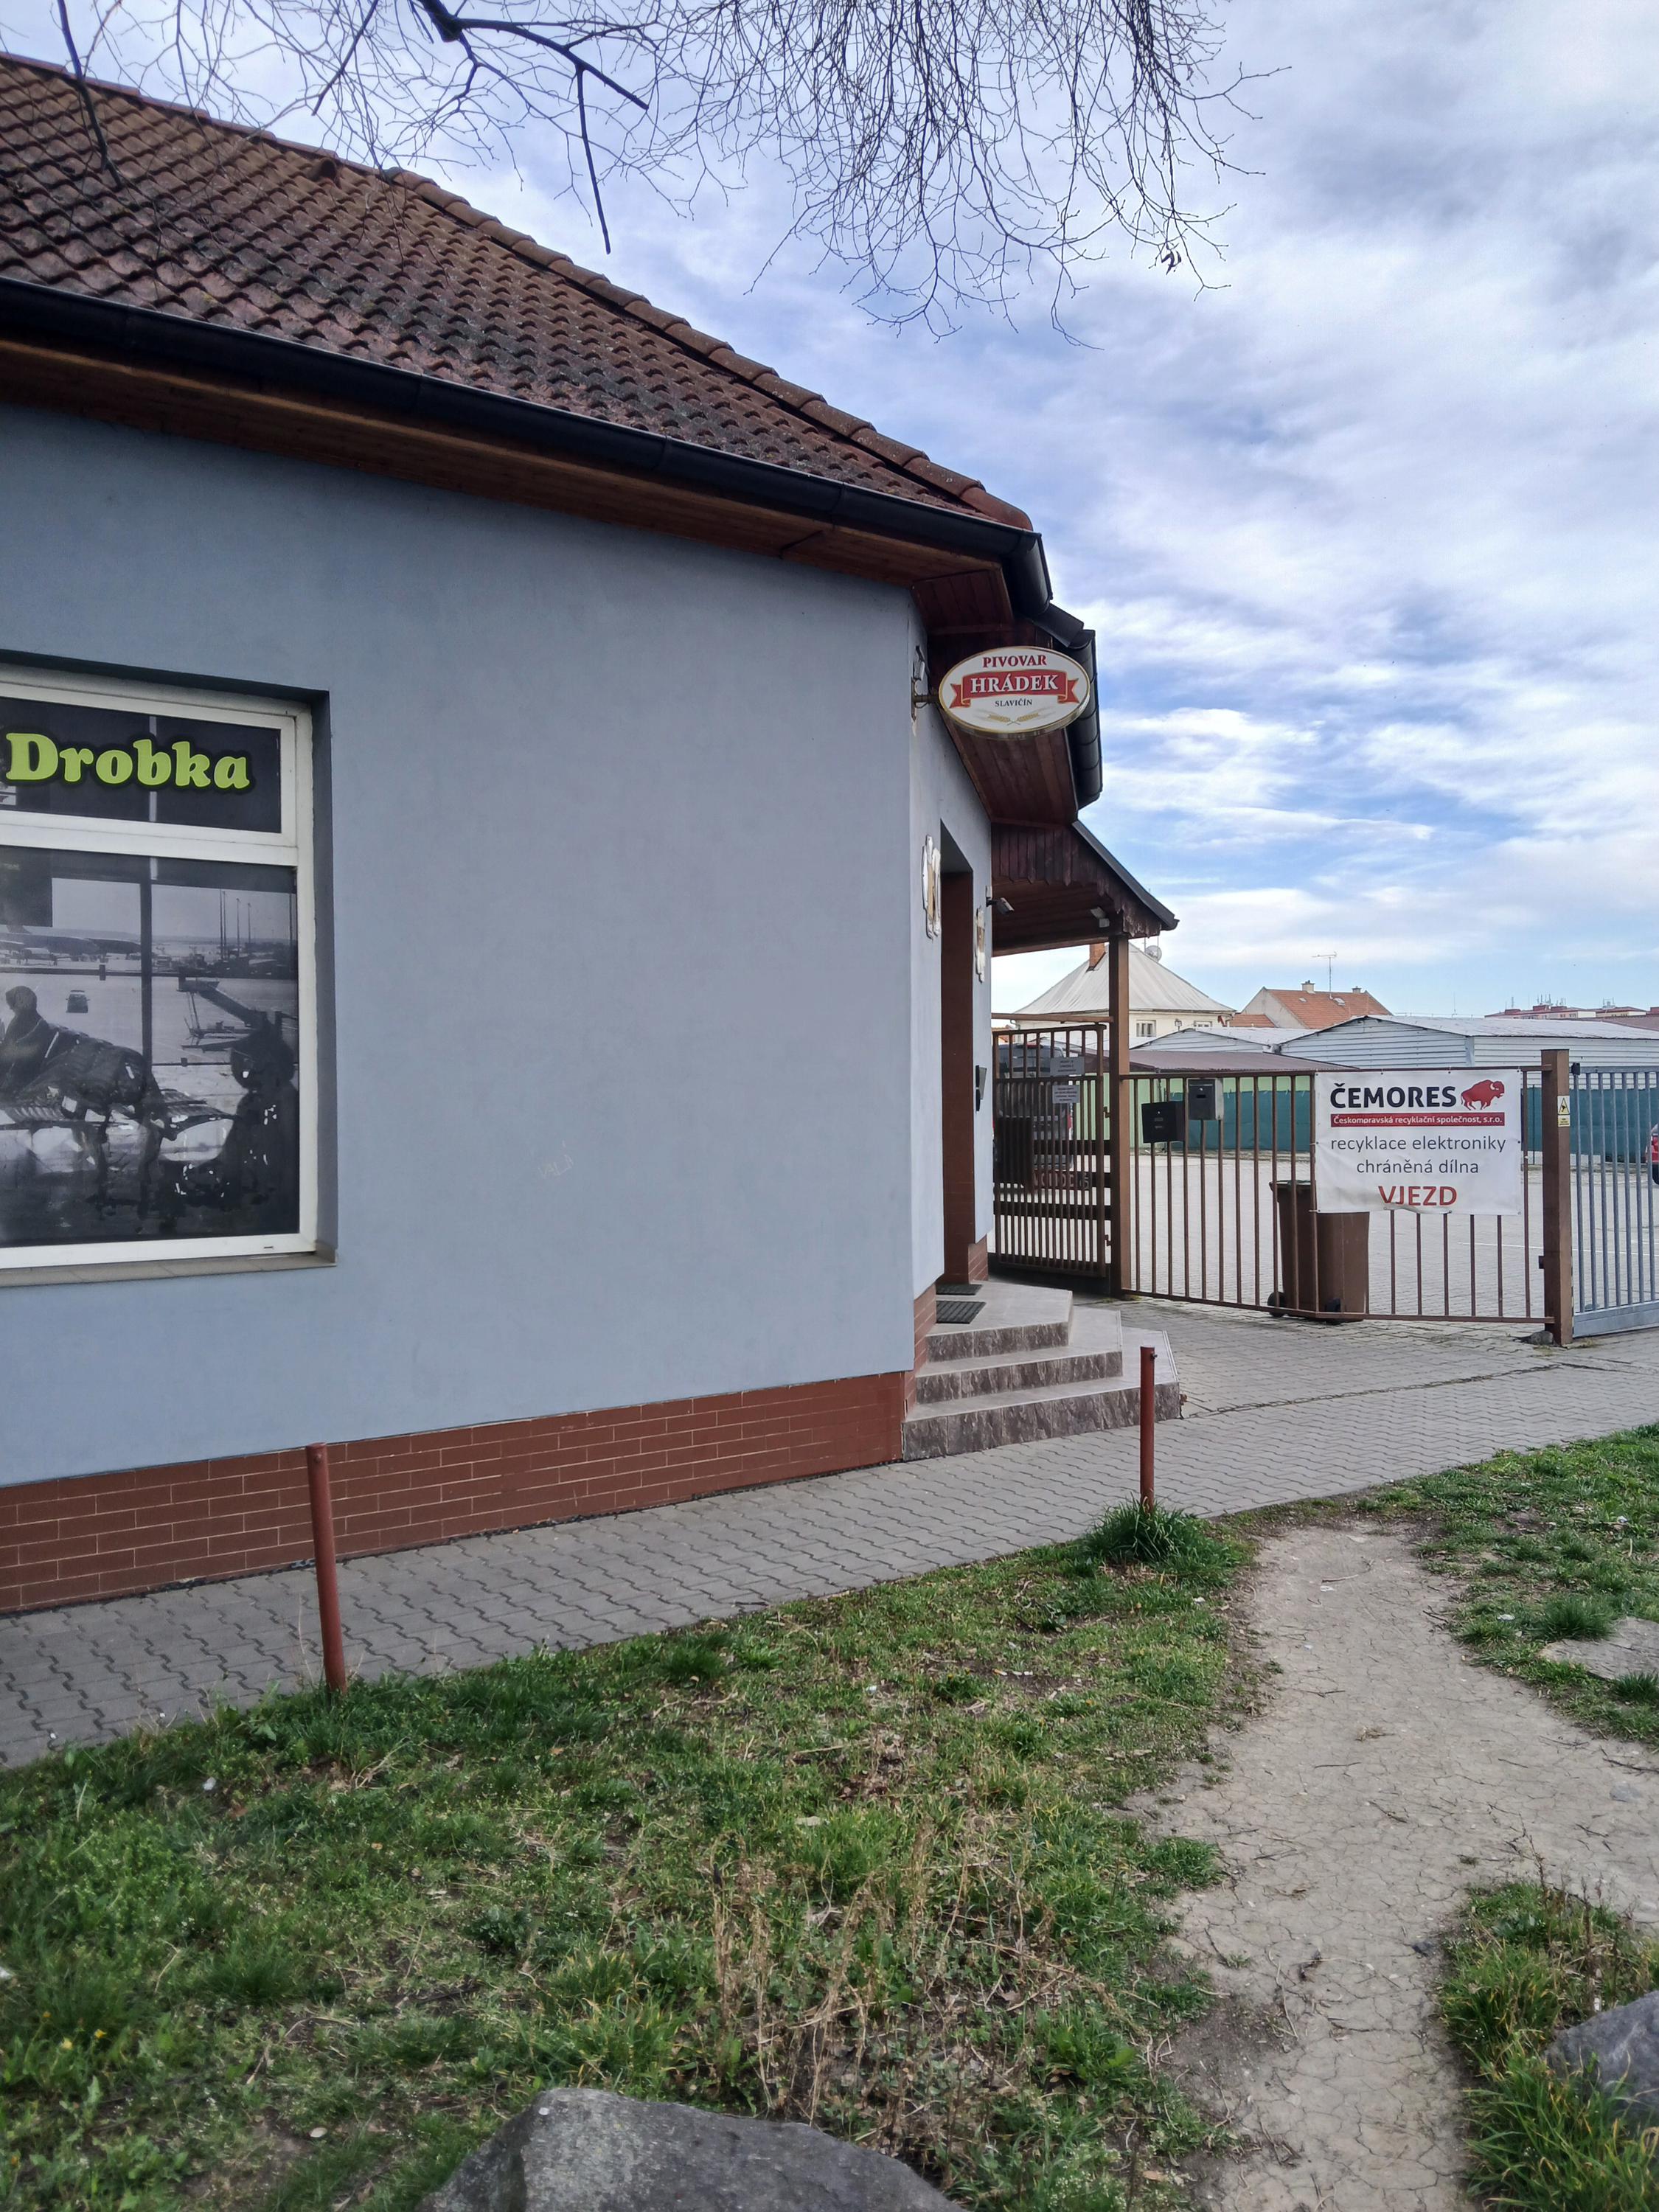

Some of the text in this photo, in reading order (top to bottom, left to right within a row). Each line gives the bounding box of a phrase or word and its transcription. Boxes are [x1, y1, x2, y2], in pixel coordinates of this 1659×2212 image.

[982, 654, 1047, 668] PIVOVAR
[970, 673, 1059, 693] HRÁDEK
[995, 698, 1033, 707] SLAVIČÍN
[5, 732, 251, 790] Drobka
[1330, 1082, 1457, 1108] ČEMORES
[1333, 1114, 1394, 1124] Českomoravská
[1395, 1116, 1435, 1124] recyklační
[1436, 1116, 1481, 1124] společnost,
[1331, 1135, 1506, 1152] recyklace elektroniky
[1357, 1159, 1479, 1174] chráněná dílna
[1377, 1186, 1458, 1206] VJEZD
